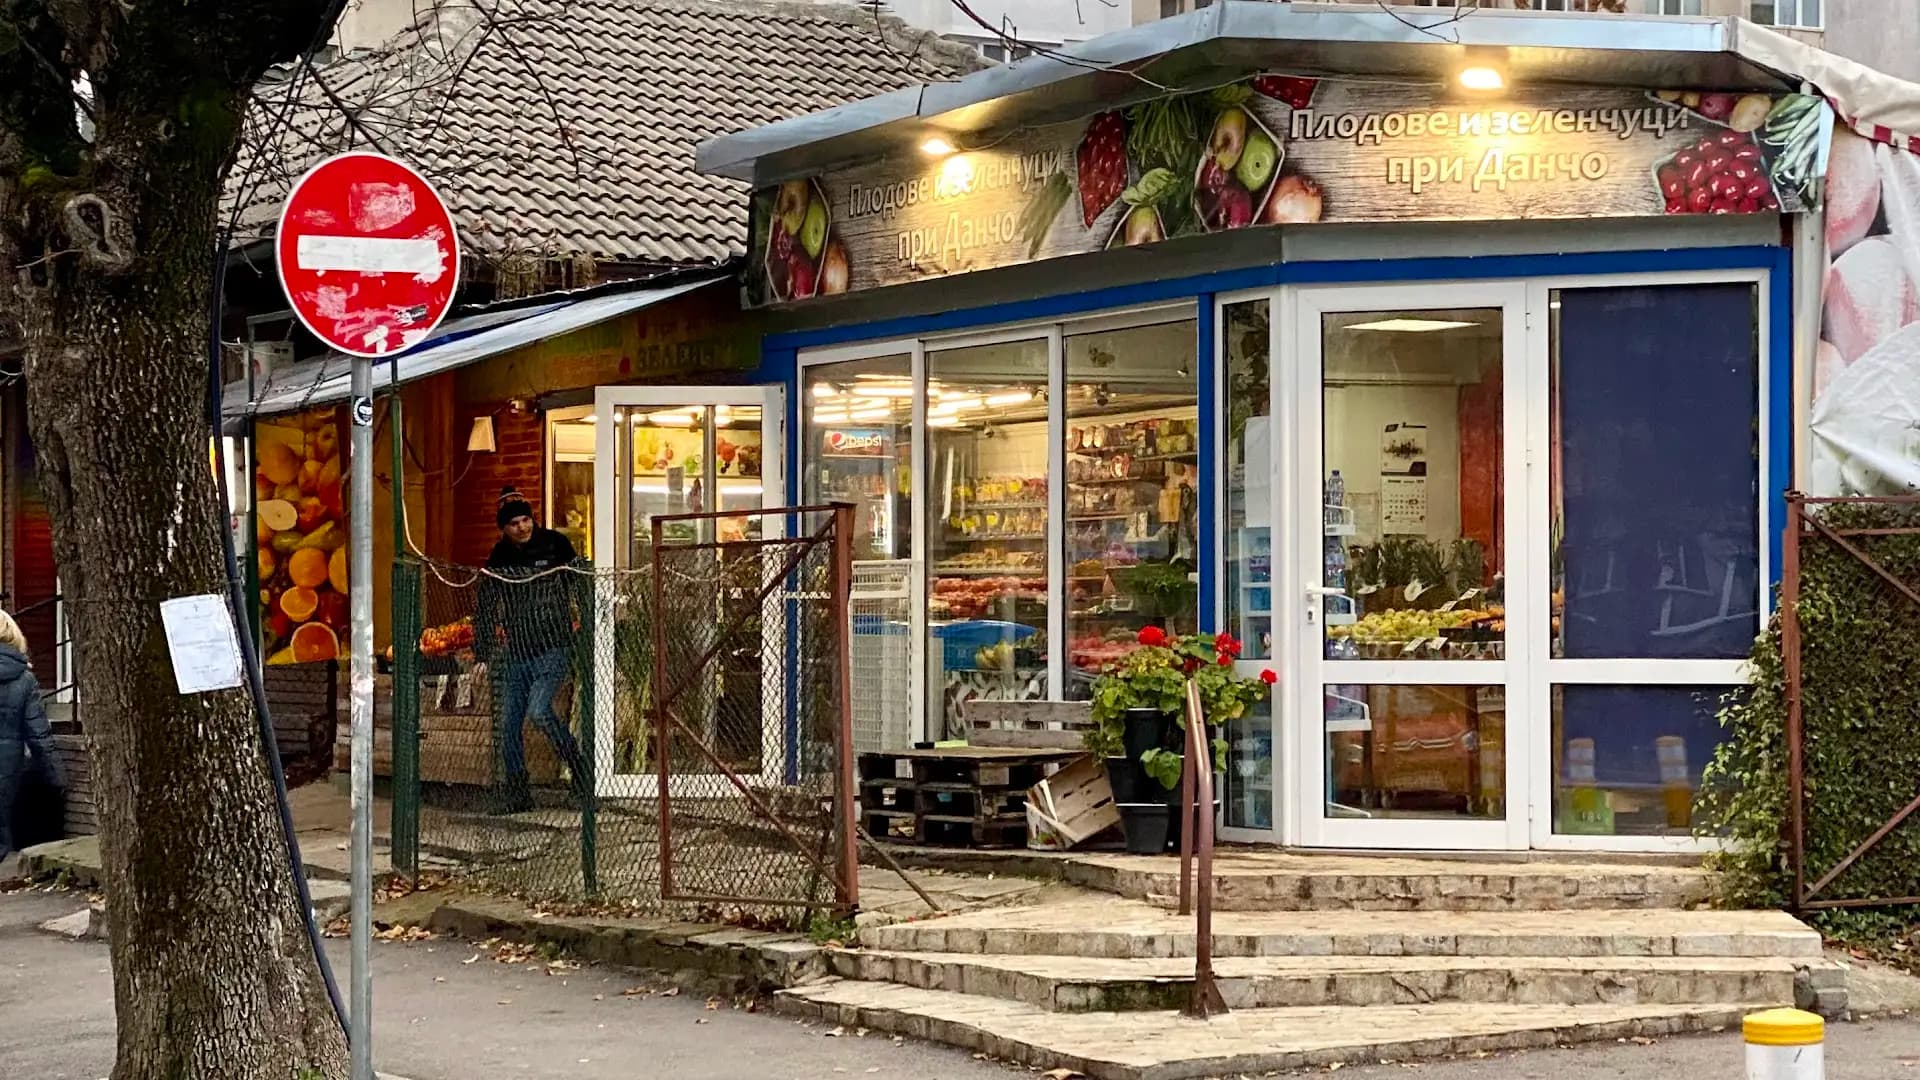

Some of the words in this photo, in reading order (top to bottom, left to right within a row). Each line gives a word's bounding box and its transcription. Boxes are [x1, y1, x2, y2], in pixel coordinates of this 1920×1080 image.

[1290, 109, 1449, 145] Плодове
[1458, 111, 1481, 136] и
[1488, 106, 1690, 140] зеленчуци
[1387, 156, 1464, 194] при
[1471, 147, 1609, 192] Данчо
[849, 176, 929, 219] Плодове
[898, 228, 938, 270] при
[943, 210, 1016, 263] Данчо
